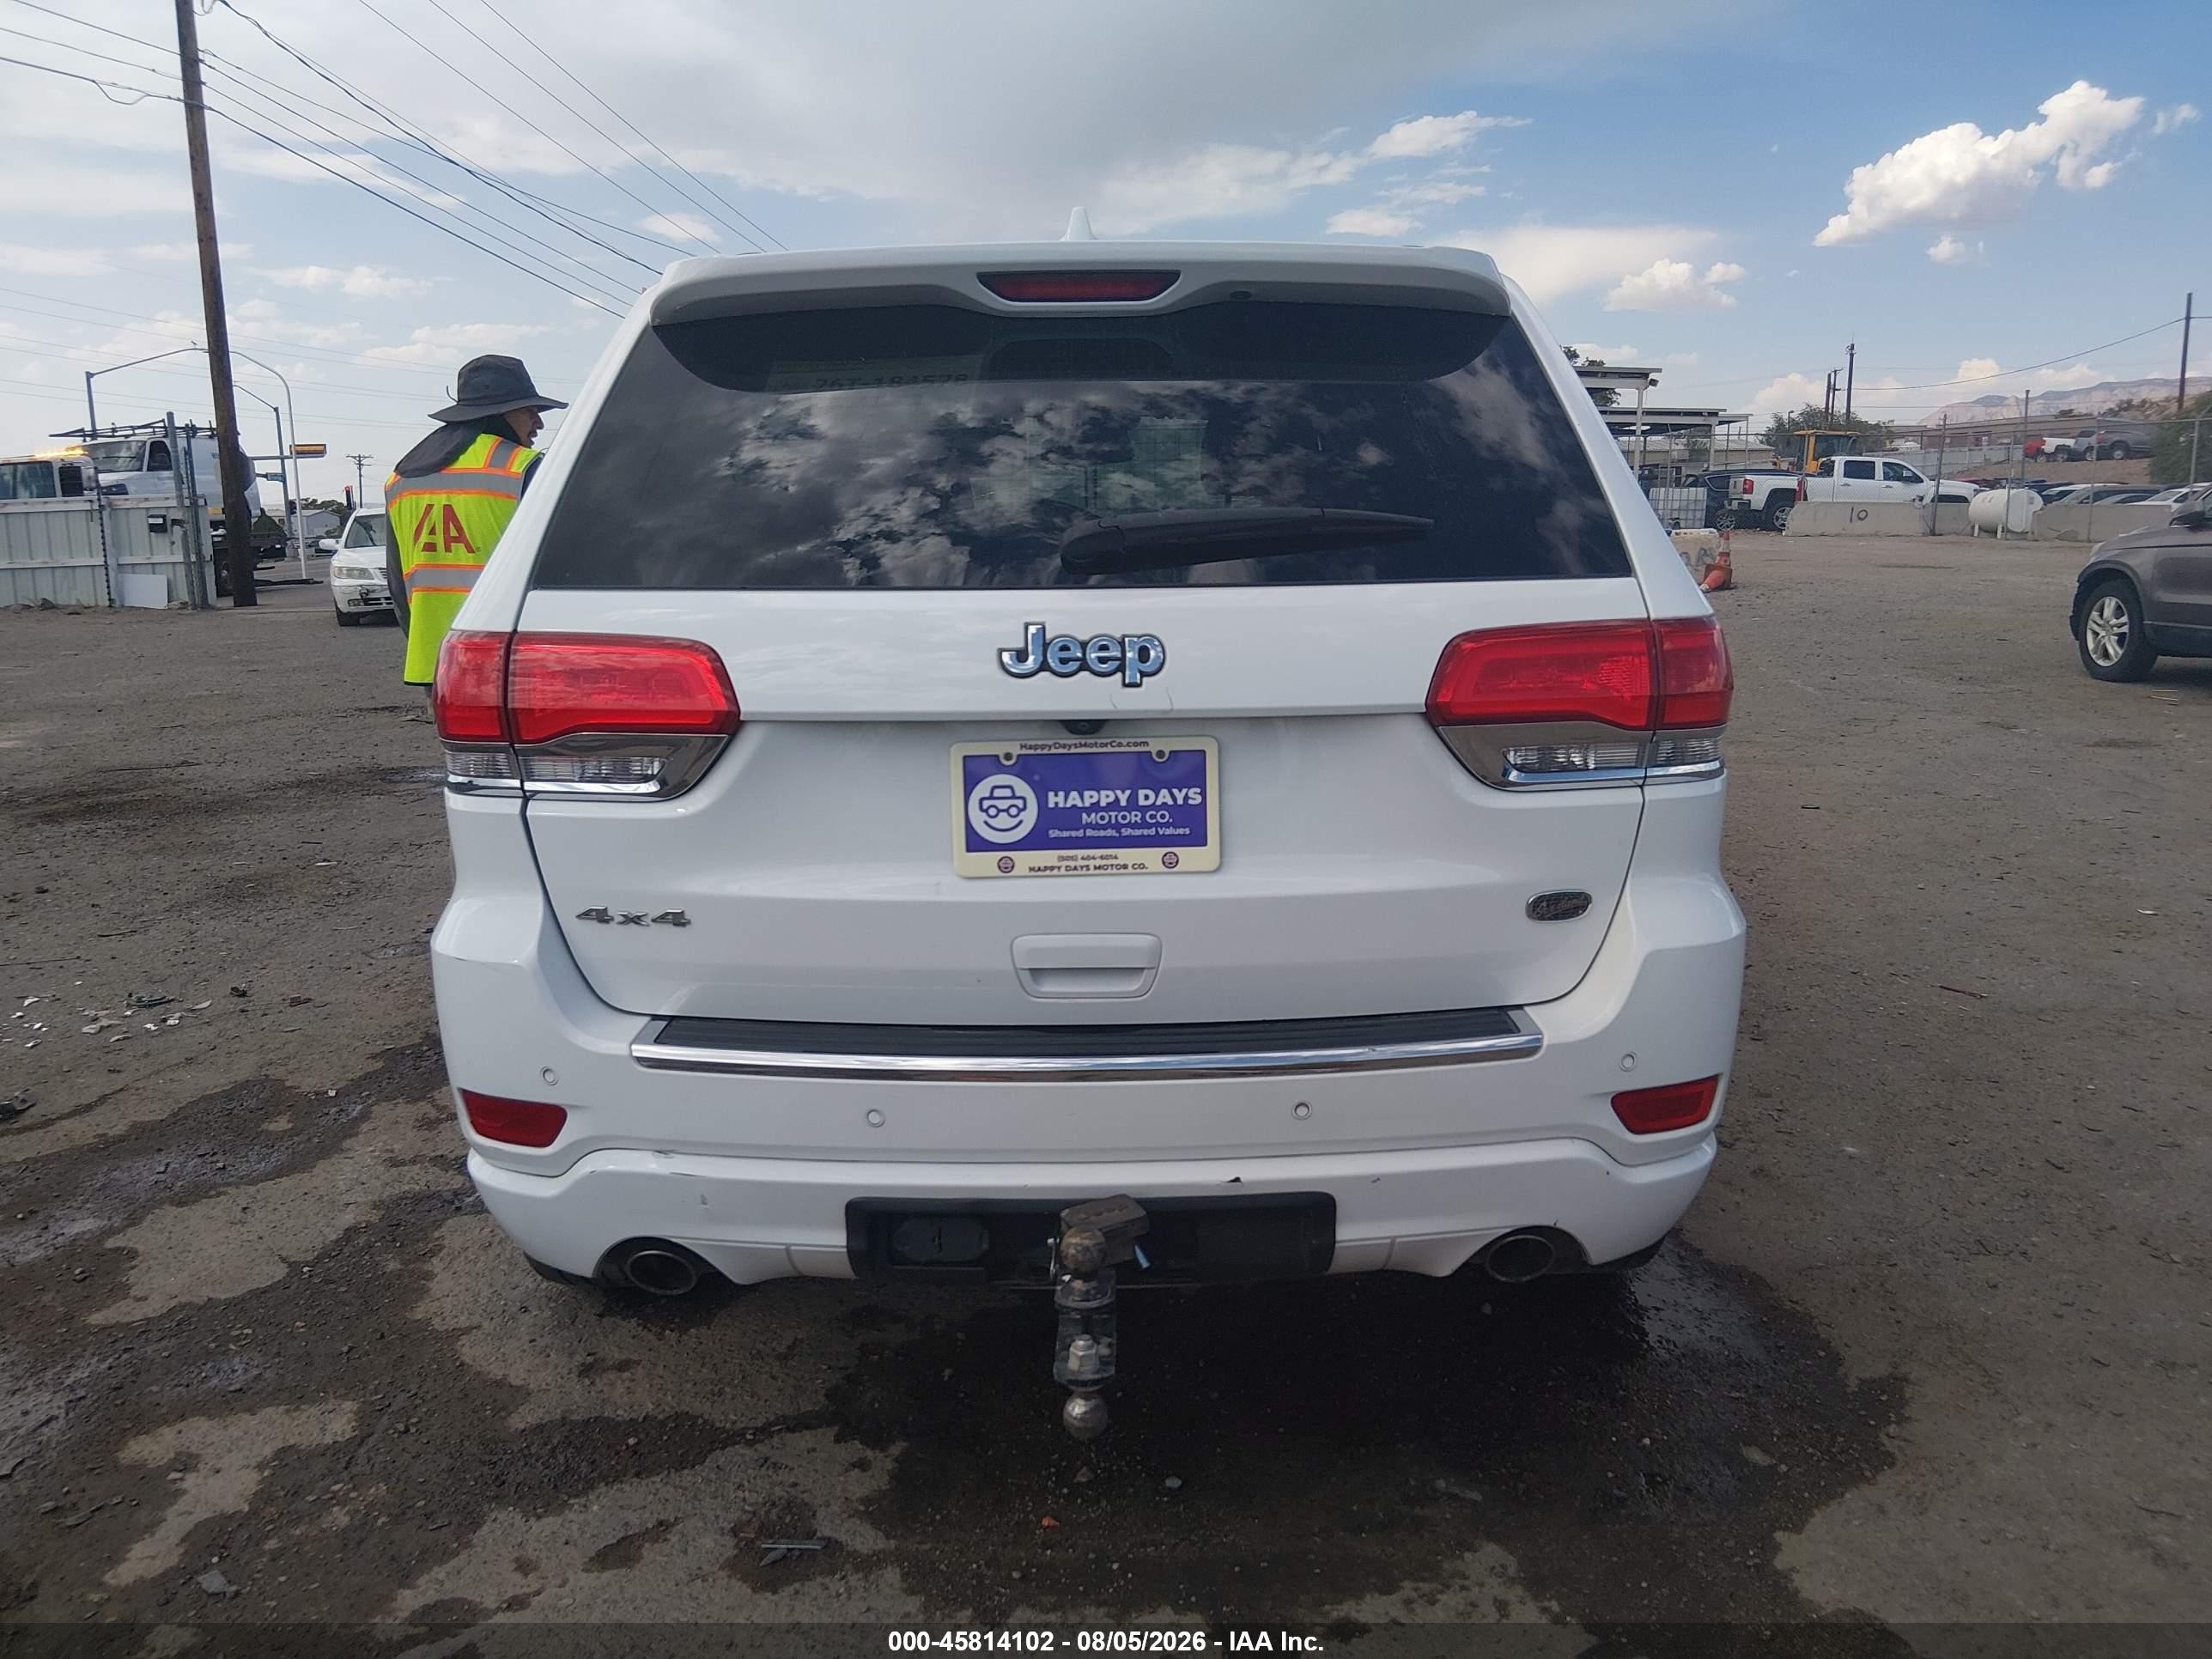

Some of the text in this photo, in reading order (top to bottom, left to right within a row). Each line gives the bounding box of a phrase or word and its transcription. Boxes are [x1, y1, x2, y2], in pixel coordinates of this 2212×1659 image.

[1850, 507, 1869, 523] 10
[998, 622, 1165, 688] Jeep
[1019, 739, 1150, 751] HappyDaysMotorCo.com
[1047, 787, 1203, 808] HAPPY DAYS
[1081, 810, 1173, 824] MOTOR CO.
[1048, 825, 1191, 838] Shared Roads, Shared Values
[1028, 862, 1149, 873] HAPPY DAYS MOTOR CO.
[575, 906, 692, 927] 4x4
